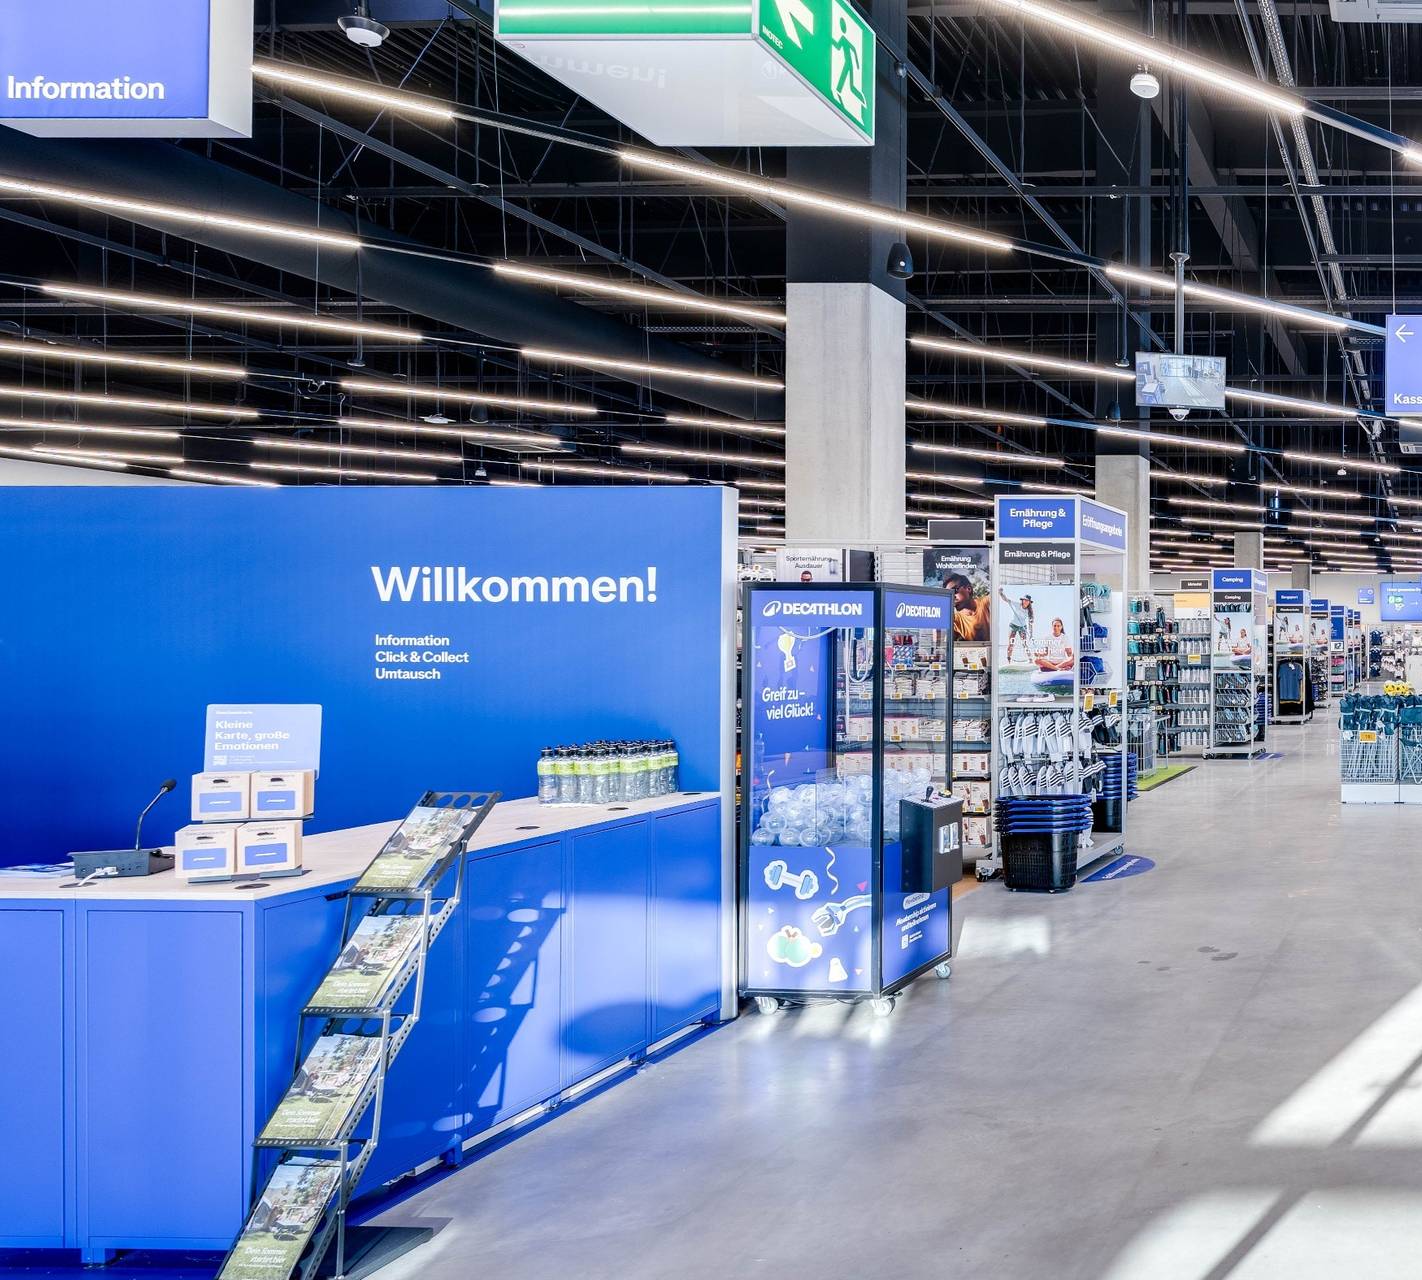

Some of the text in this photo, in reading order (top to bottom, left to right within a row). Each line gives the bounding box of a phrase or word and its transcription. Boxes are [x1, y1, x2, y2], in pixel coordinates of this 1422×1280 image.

[762, 24, 784, 50] INOTEC
[7, 75, 165, 100] Information
[1009, 508, 1067, 519] Ernährung &
[1023, 519, 1054, 530] Pflege
[940, 556, 972, 564] Ernährung
[1004, 550, 1041, 560] Ernährung
[1047, 550, 1071, 560] Pflege
[371, 566, 657, 603] Willkommen!
[782, 603, 863, 617] DECATHLON
[905, 607, 942, 619] DECATHLON
[375, 634, 450, 647] Information
[375, 651, 469, 663] Click & Collect
[375, 667, 441, 680] Umtausch
[762, 687, 787, 702] Greif
[787, 691, 799, 701] zu
[766, 702, 814, 720] viel Glück!
[215, 720, 253, 729] Kleine
[215, 730, 290, 741] Karte, große
[214, 742, 279, 751] Emotionen
